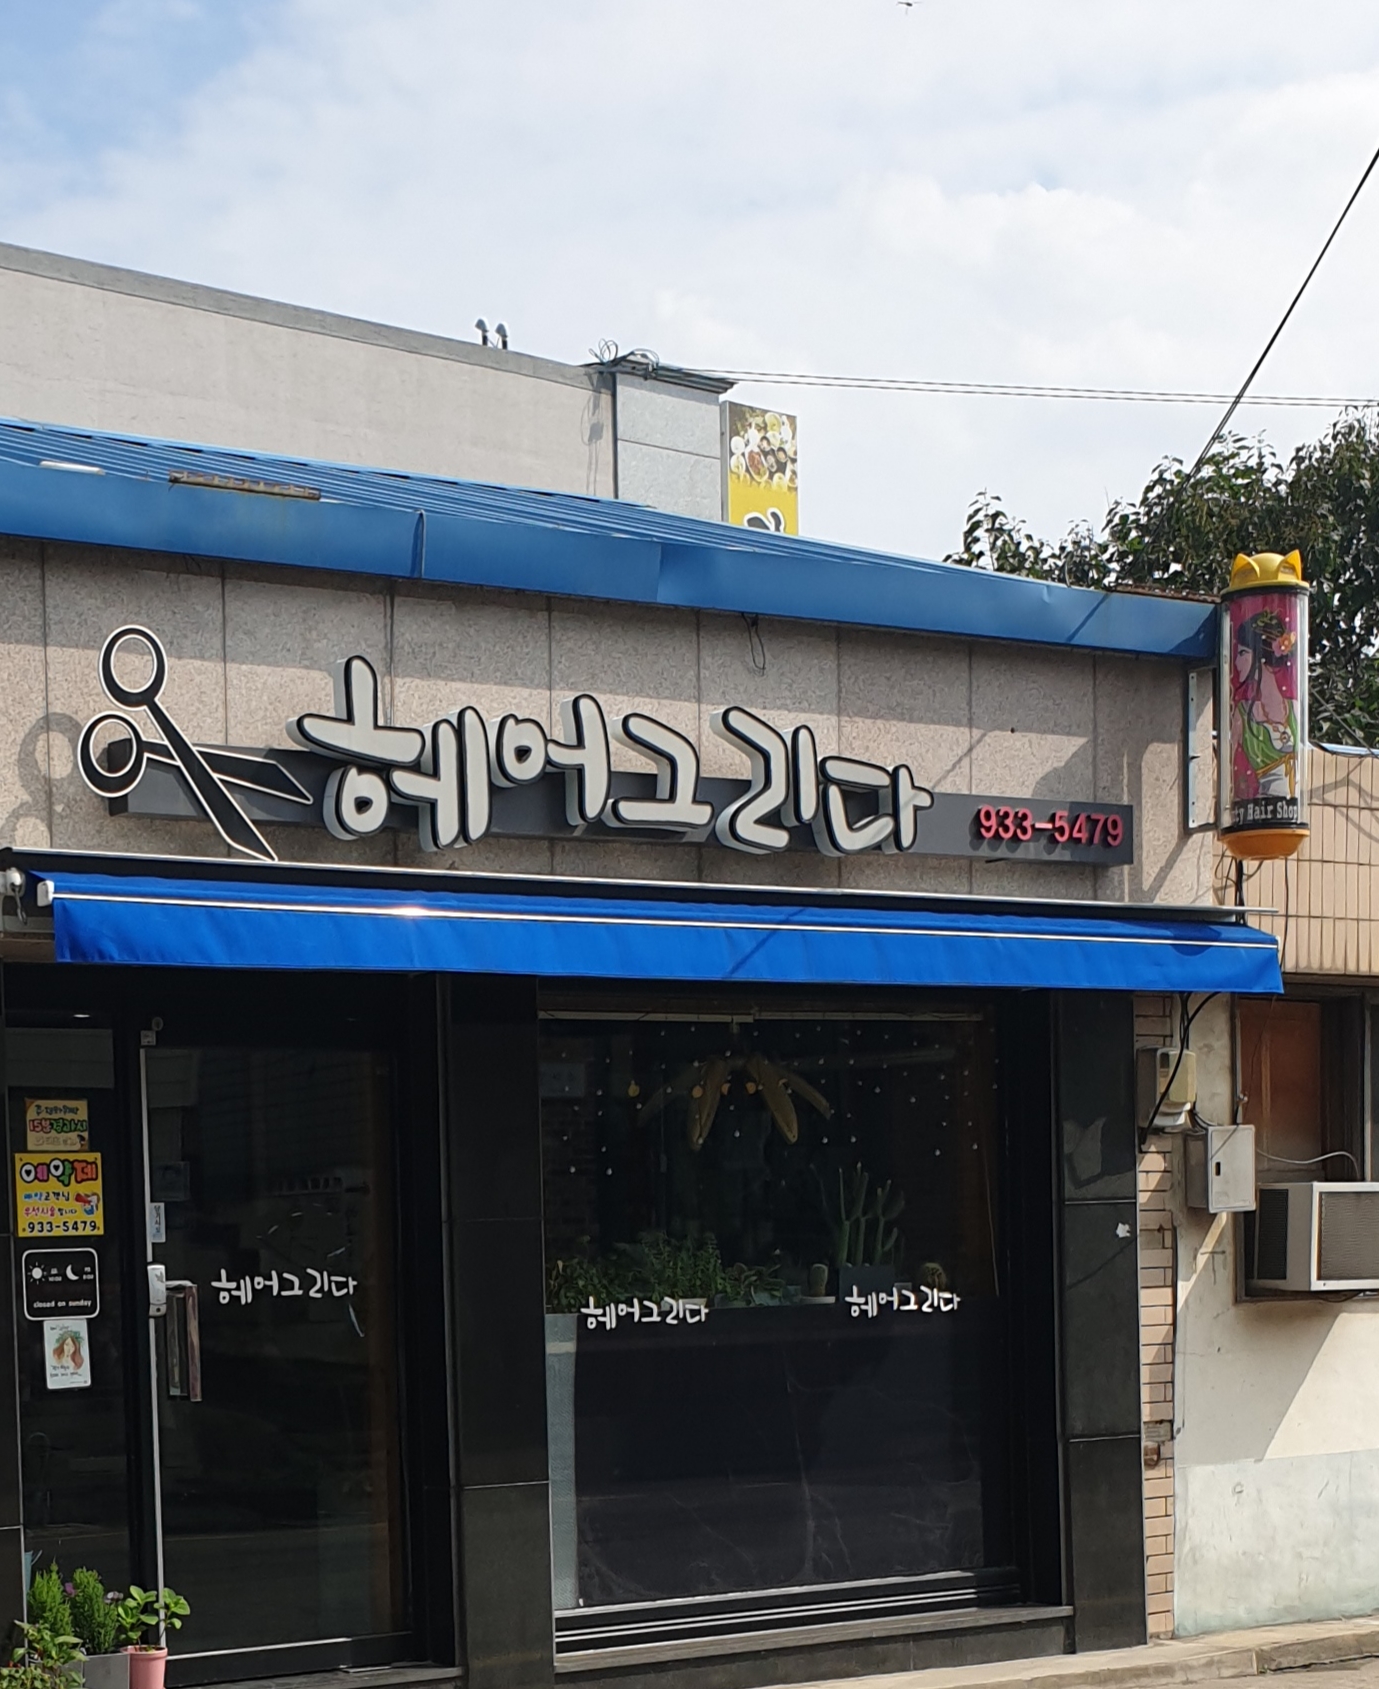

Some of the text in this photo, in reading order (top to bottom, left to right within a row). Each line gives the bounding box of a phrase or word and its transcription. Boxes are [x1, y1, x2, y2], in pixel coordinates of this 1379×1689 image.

[287, 655, 935, 856] 헤어그리다
[978, 804, 1124, 847] 933-5479
[1247, 802, 1273, 820] Hair
[1276, 800, 1299, 821] Shop
[19, 1157, 99, 1188] 예약제
[27, 1220, 97, 1233] 933-5479
[211, 1268, 358, 1306] 헤어그리다
[844, 1285, 961, 1318] 헤어그리다
[33, 1300, 55, 1309] closed
[579, 1296, 710, 1330] 헤어그리다
